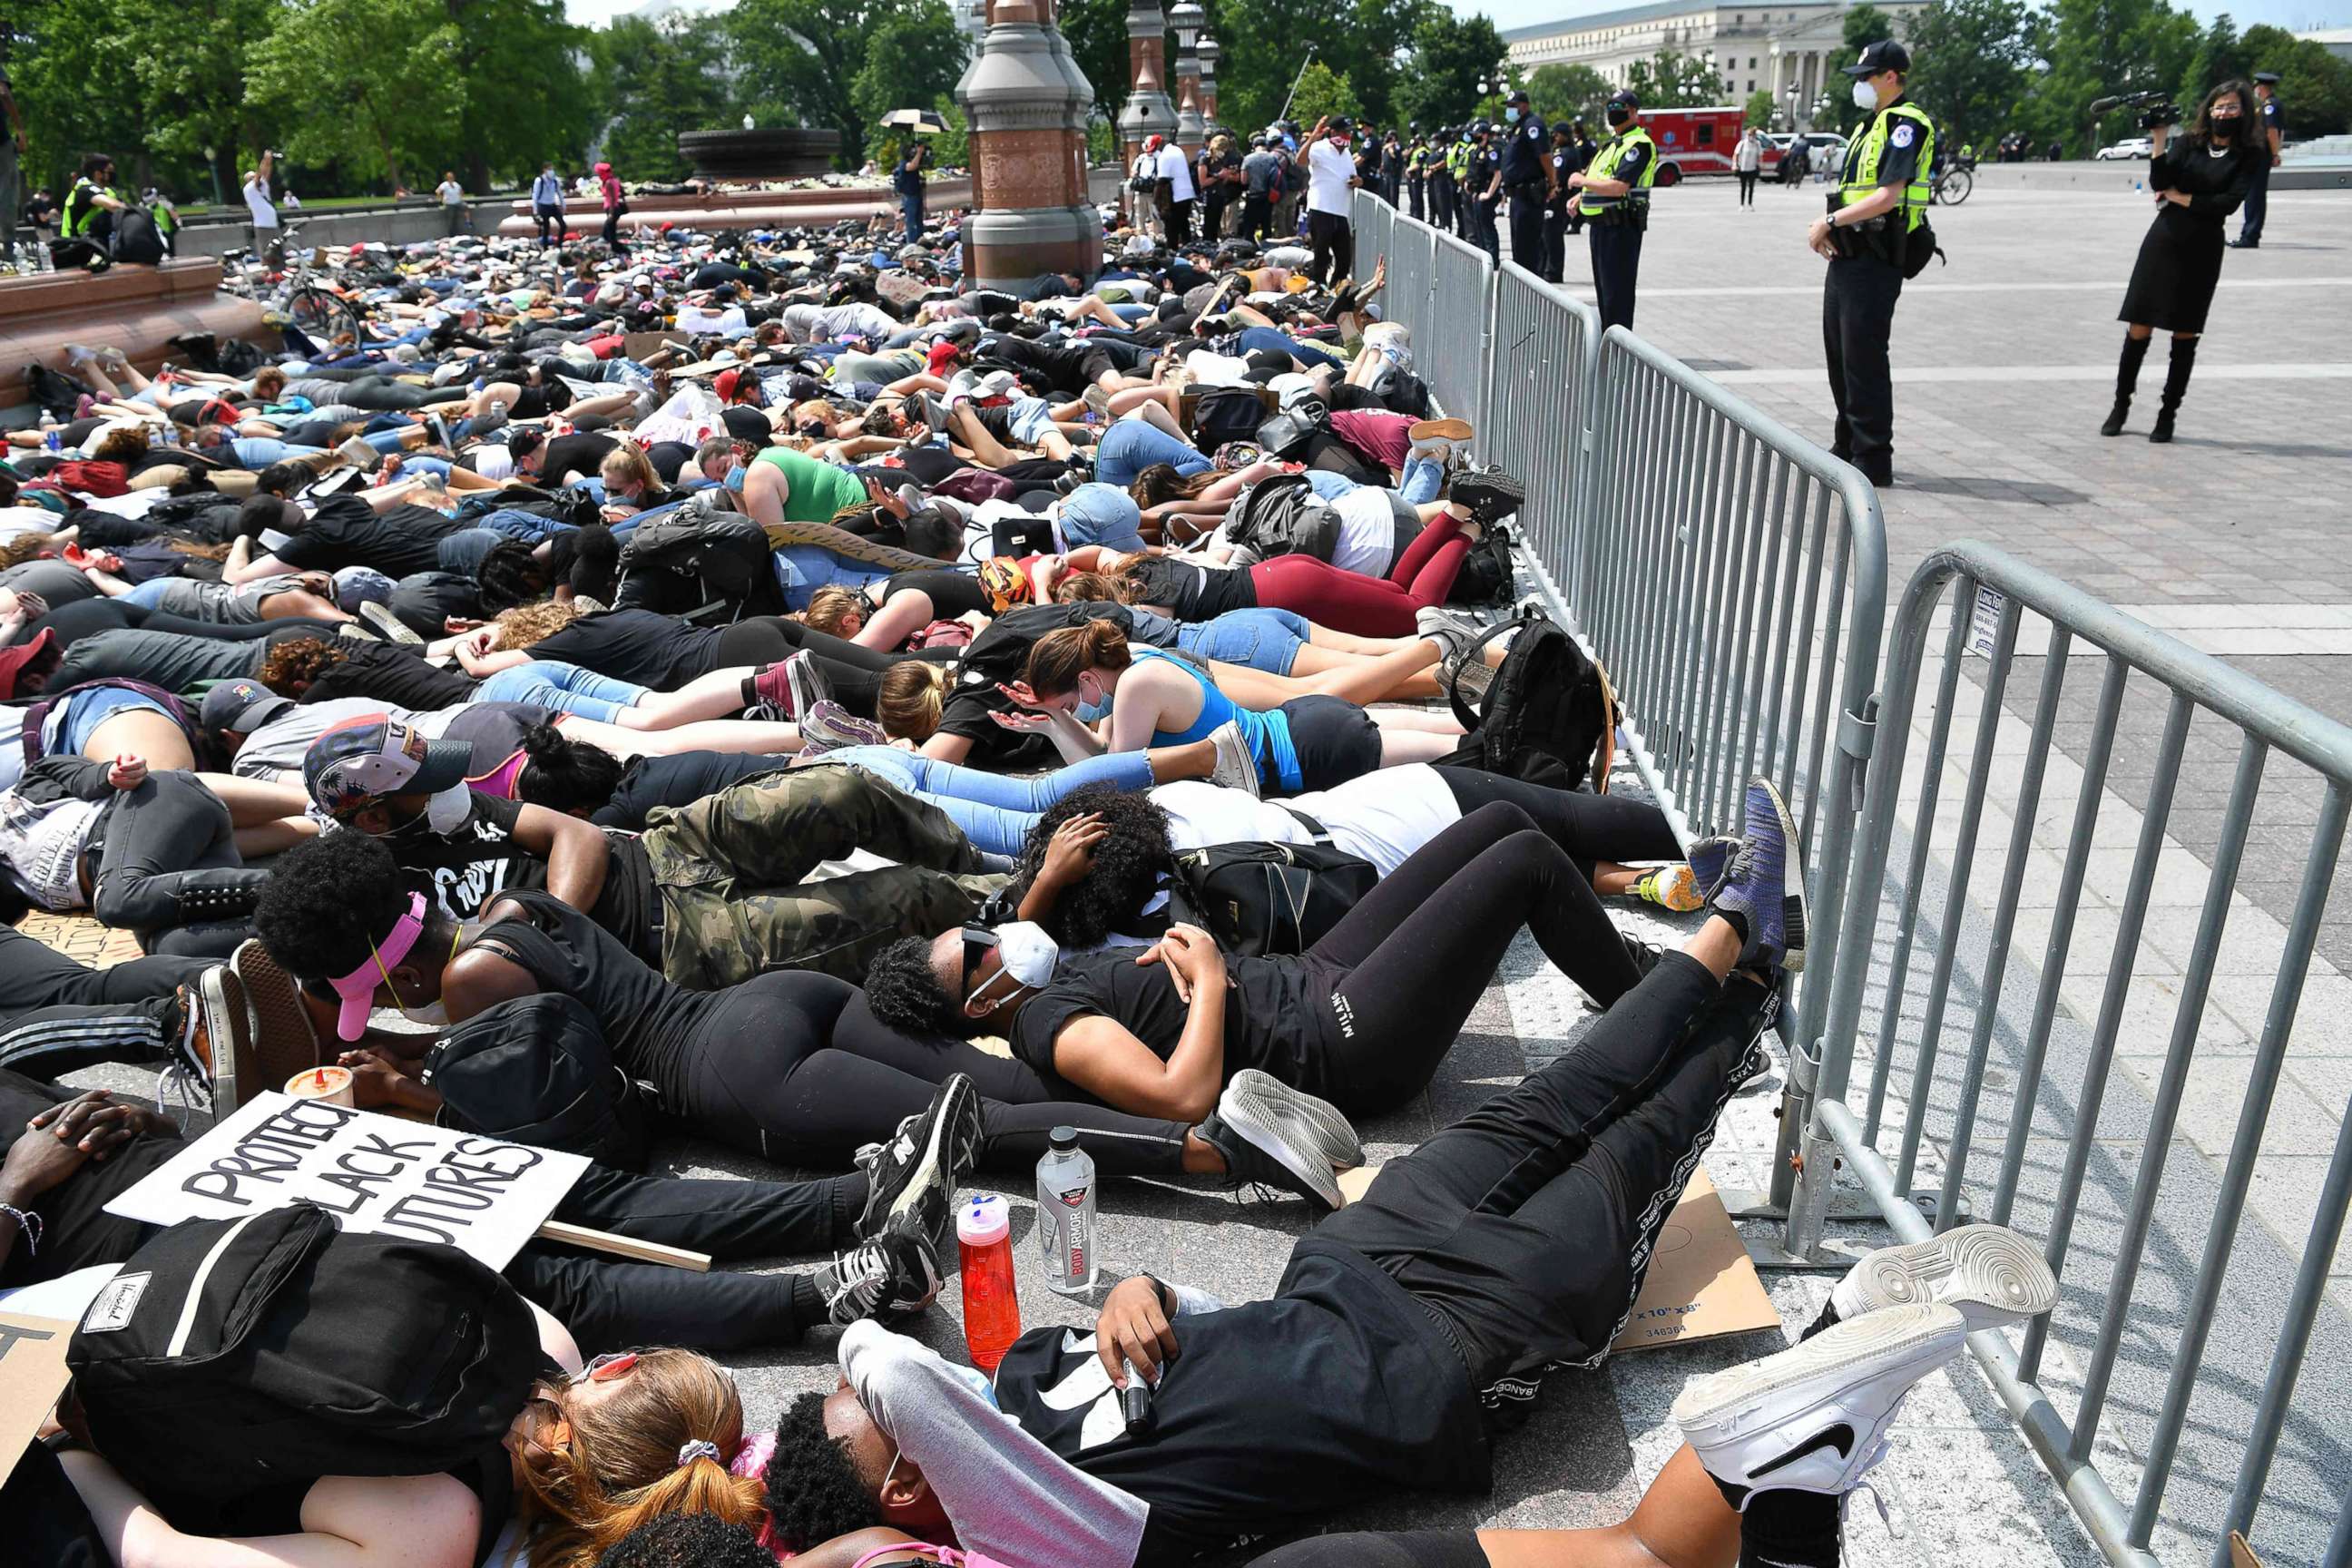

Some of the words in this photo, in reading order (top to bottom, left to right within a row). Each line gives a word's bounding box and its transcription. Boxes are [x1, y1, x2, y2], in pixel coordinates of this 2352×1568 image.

[1866, 122, 1880, 178] OLICE
[1330, 992, 1355, 1039] MILANO
[181, 1098, 360, 1206] PROTECT
[1697, 1132, 1713, 1146] THE
[372, 1138, 544, 1246] UTURES
[1069, 1210, 1084, 1277] BODYARMOR
[108, 1284, 136, 1320] Herschel
